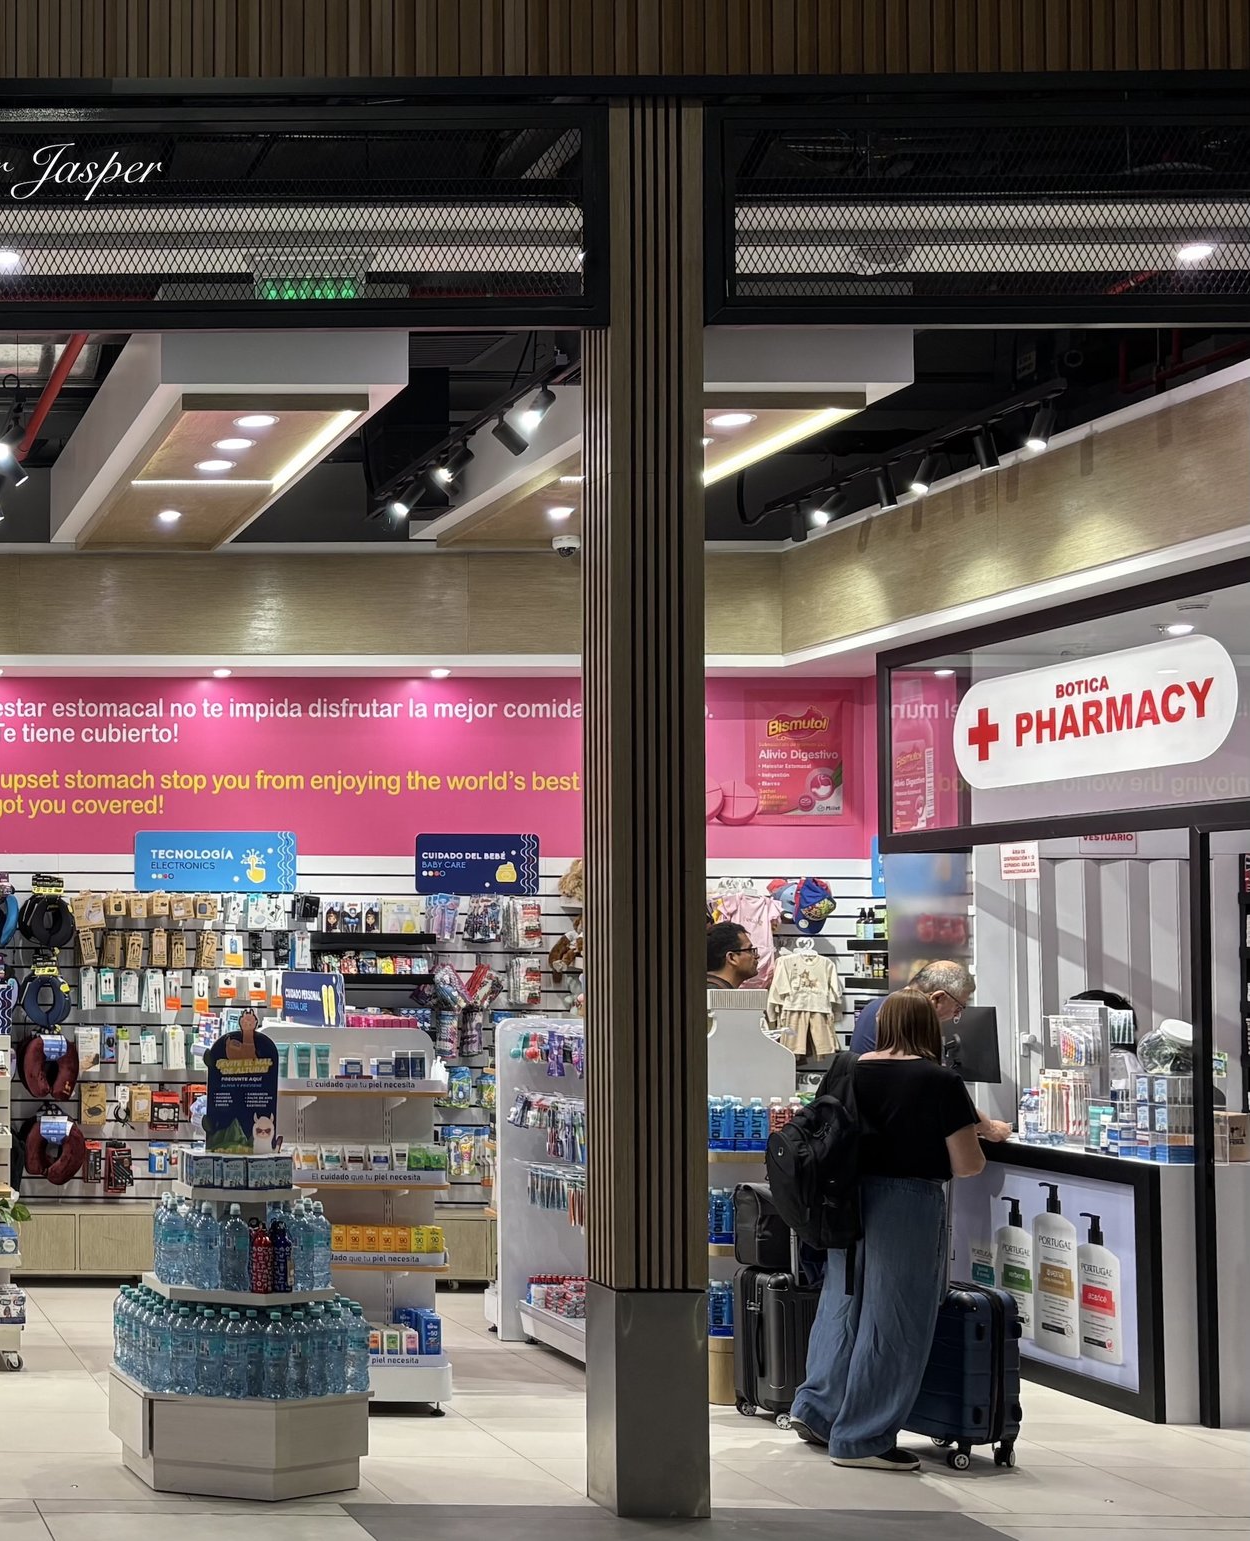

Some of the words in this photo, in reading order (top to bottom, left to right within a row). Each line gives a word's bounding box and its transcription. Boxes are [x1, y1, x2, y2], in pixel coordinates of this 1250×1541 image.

[1055, 675, 1109, 699] BOTICA
[52, 698, 164, 718] estomacal
[170, 702, 197, 718] no
[202, 699, 224, 718] te
[229, 698, 302, 722] impida
[308, 698, 404, 719] disfrutar
[409, 698, 428, 719] la
[434, 698, 498, 723] mejor
[503, 698, 583, 719] comida
[1015, 676, 1214, 748] PHARMACY
[21, 723, 76, 743] tiene
[81, 723, 179, 743] cubierto!
[768, 717, 828, 737] Bismutol
[758, 750, 788, 759] Alivio
[791, 750, 839, 761] Digestivo
[0, 770, 60, 795] upset
[64, 770, 154, 790] stomach
[160, 770, 207, 794] stop
[211, 774, 250, 794] you
[255, 770, 304, 790] from
[310, 770, 401, 795] enjoying
[406, 770, 441, 790] the
[532, 771, 581, 791] best
[27, 799, 66, 819] you
[71, 795, 164, 815] covered!
[150, 847, 235, 860] TECNOLOGÍA
[421, 851, 464, 861] CUIDADO
[465, 852, 482, 861] DEL
[483, 850, 506, 861] BEBÉ
[150, 861, 216, 871] ELECTRONICS
[421, 861, 444, 870] BABY
[445, 861, 467, 869] CARE
[345, 1082, 358, 1090] que
[368, 1080, 382, 1089] piel
[374, 1174, 388, 1182] piel
[1039, 1235, 1072, 1250] PORTUGAL
[1002, 1243, 1030, 1257] PORTUGAL
[372, 1254, 386, 1263] piel
